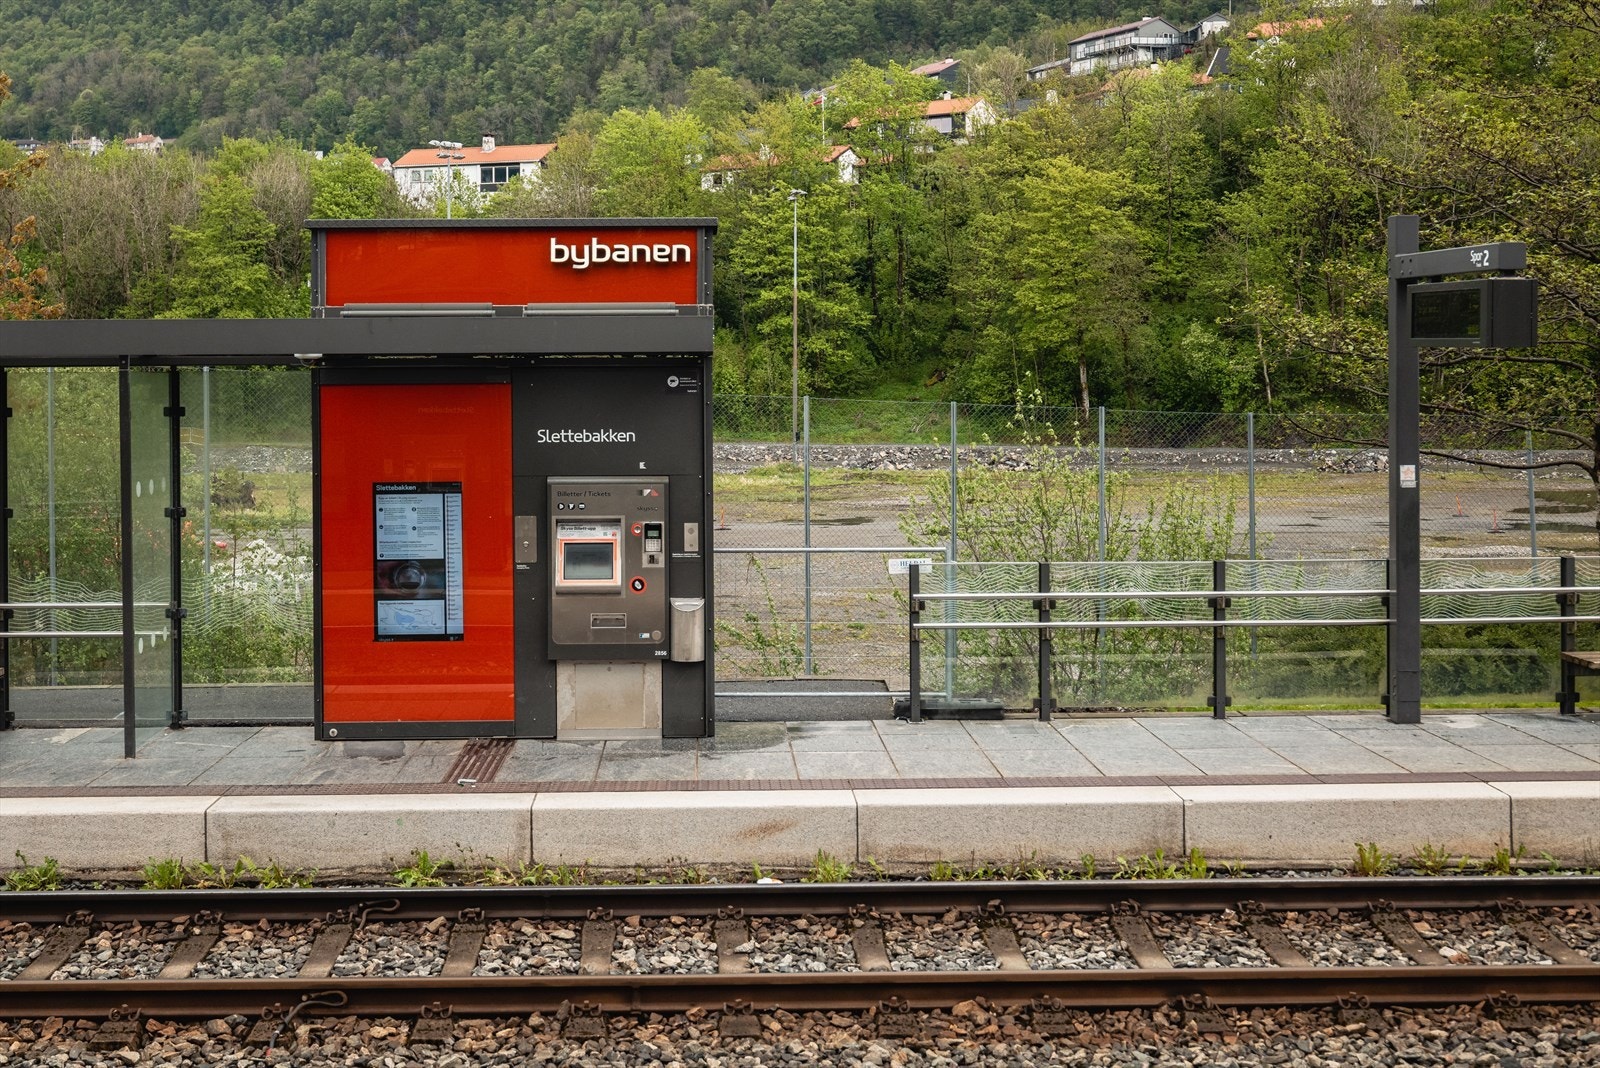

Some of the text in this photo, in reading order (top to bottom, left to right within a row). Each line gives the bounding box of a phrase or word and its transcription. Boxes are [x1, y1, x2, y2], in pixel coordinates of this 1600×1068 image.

[550, 237, 691, 270] bybanen
[1470, 249, 1490, 266] Spor 2
[537, 428, 636, 443] Slettebakken
